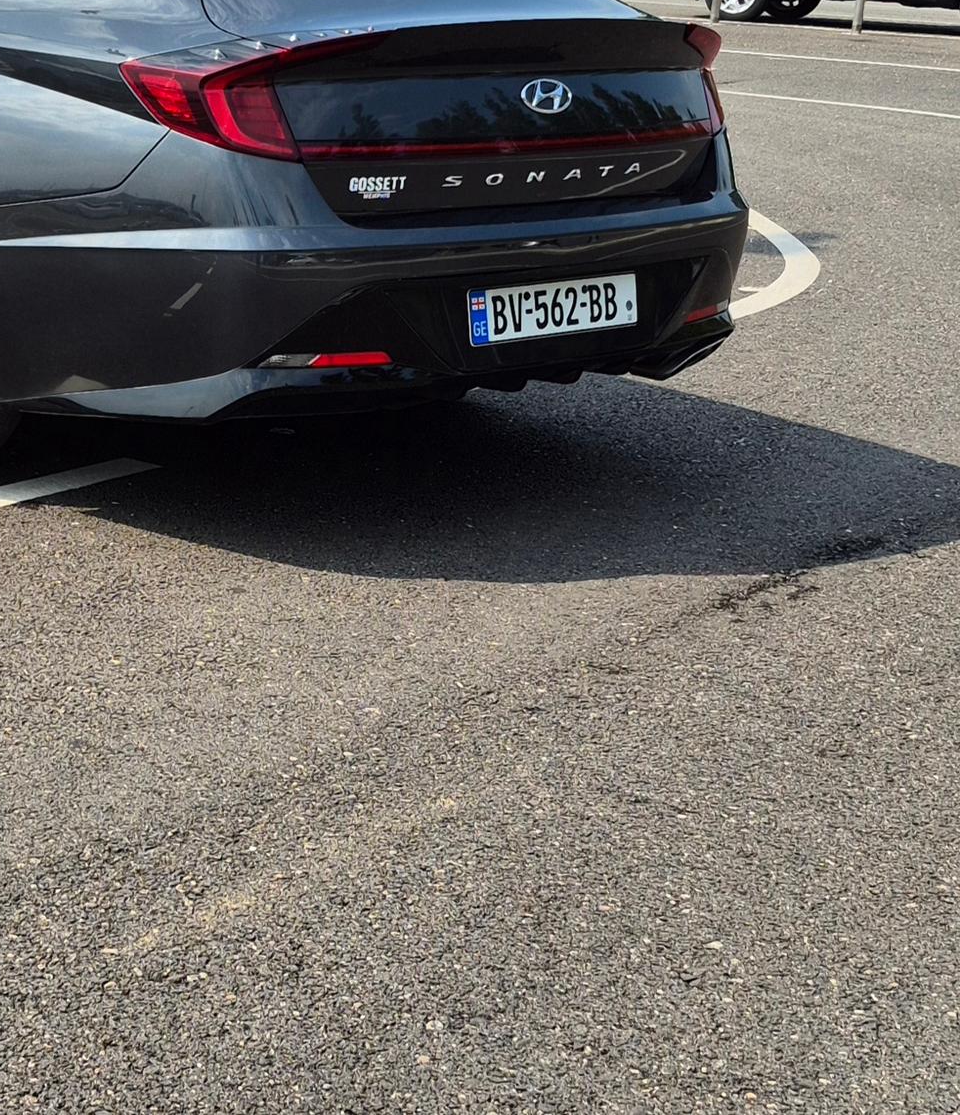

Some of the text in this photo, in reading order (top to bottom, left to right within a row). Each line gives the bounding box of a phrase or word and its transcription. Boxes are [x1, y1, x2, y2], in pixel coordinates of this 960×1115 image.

[349, 176, 407, 192] GOSSETT
[442, 162, 640, 187] SONATA
[473, 282, 618, 337] GE BV-562-BB
